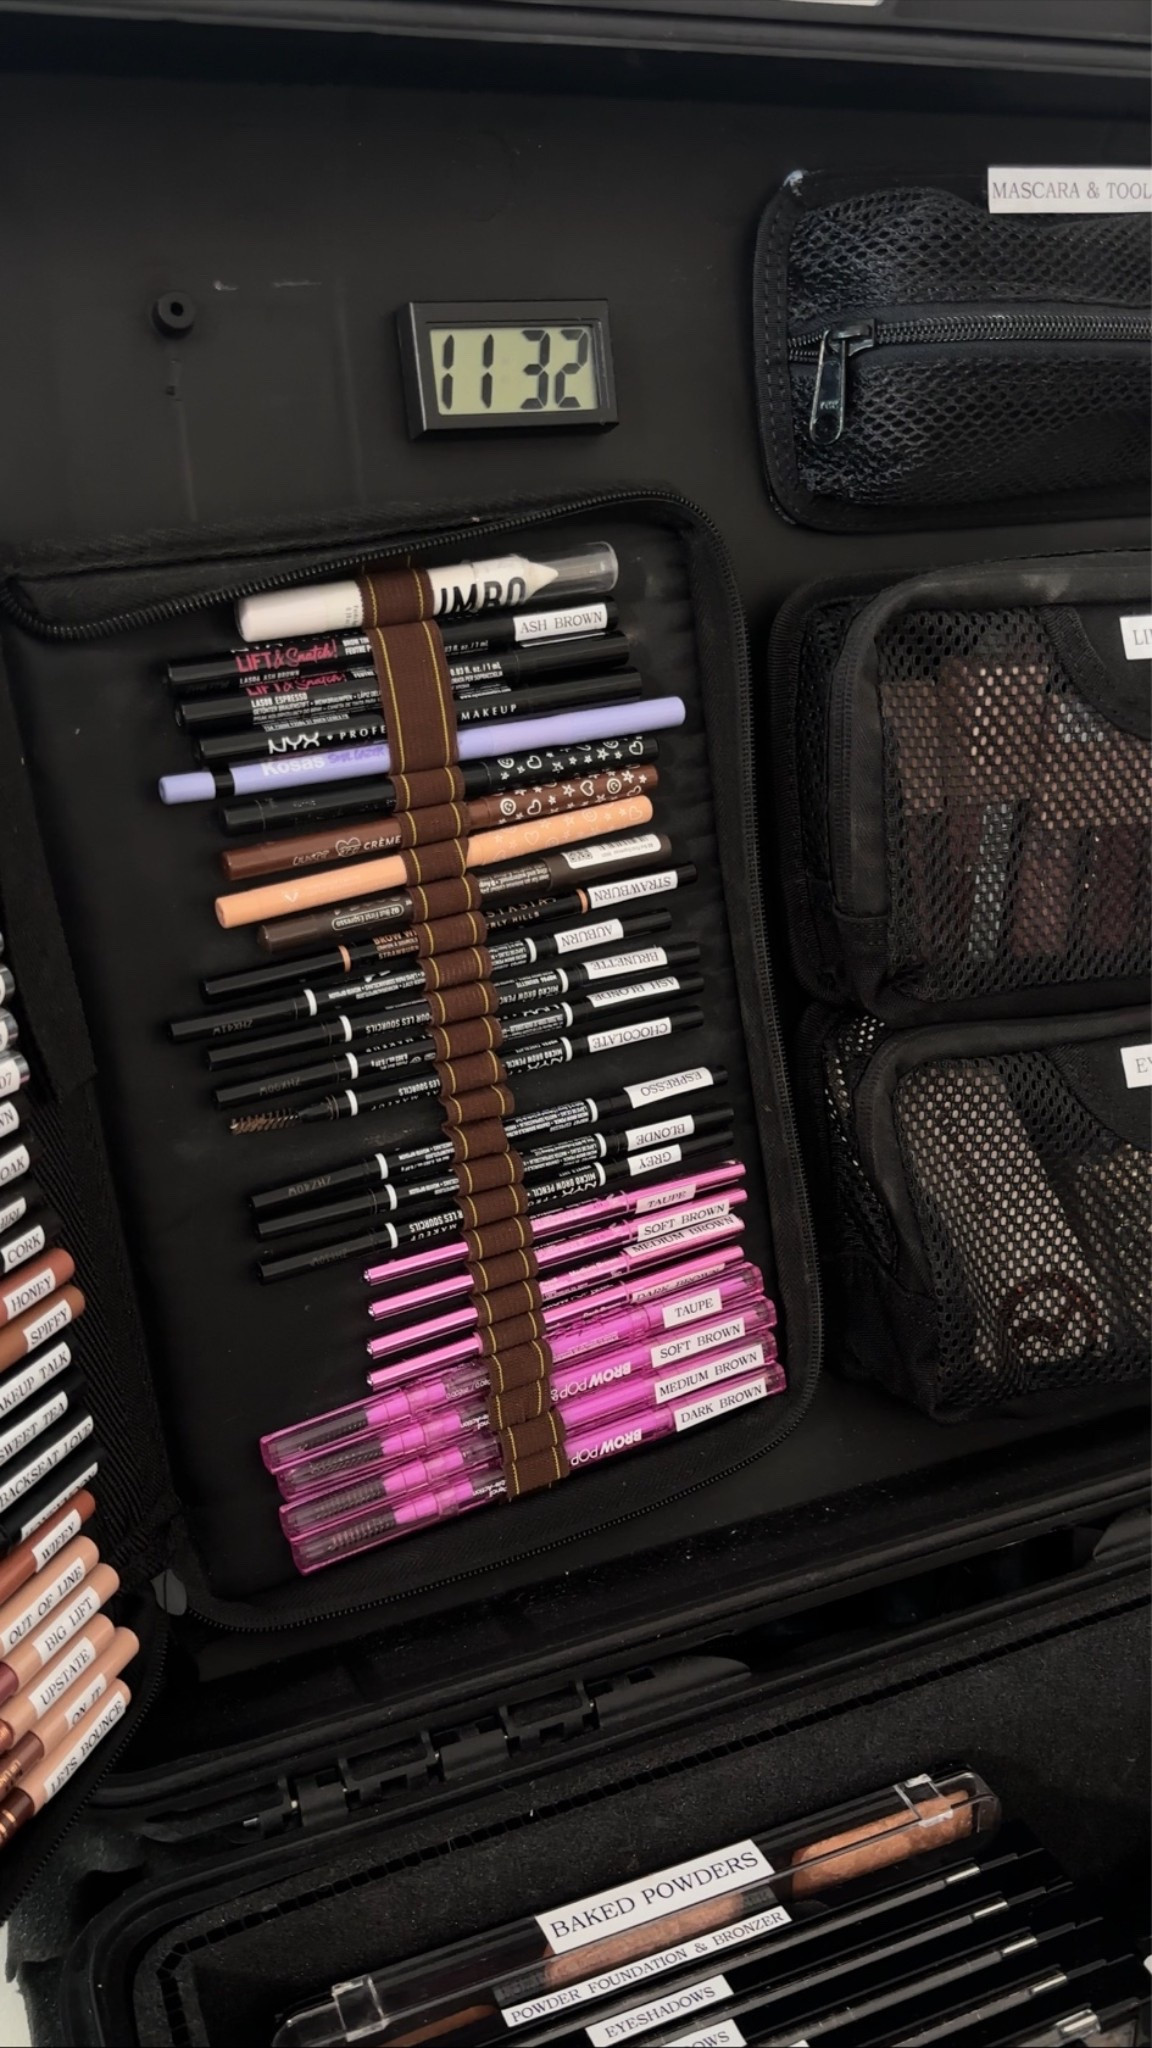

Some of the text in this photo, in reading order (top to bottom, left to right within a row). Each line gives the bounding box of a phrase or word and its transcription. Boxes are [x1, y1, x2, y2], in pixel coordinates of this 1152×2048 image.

[992, 182, 1081, 199] MASCARA
[1087, 182, 1100, 199] &
[521, 611, 603, 634] ASH BROWN
[235, 651, 271, 672] LIFT
[268, 732, 320, 754] NYX
[461, 704, 517, 720] MAKEUP
[261, 756, 326, 776] Kosas
[363, 835, 401, 850] CRÈME
[594, 875, 672, 902] STRAWBURN
[561, 924, 613, 947] AUBURN
[591, 951, 660, 971] BRUNETTE
[593, 1022, 668, 1049] CHOCOLATE
[640, 1071, 703, 1097] ESPRESSO
[635, 1123, 686, 1141] BLONDE
[638, 1152, 672, 1170] GREY
[531, 1183, 555, 1197] PENCIL
[647, 1190, 687, 1208] TAUPE
[407, 1215, 443, 1232] SOURCILS
[442, 1211, 457, 1223] LES
[643, 1204, 725, 1236] SOFT BROWN
[8, 1232, 41, 1264] CORK
[632, 1216, 734, 1253] MEDIUM BROWN
[11, 1278, 52, 1312] HONEY
[674, 1298, 714, 1318] TAUPE
[30, 1308, 69, 1345] SPIFFY
[660, 1324, 742, 1359] SOFT BROWN
[38, 1350, 69, 1381] TALK
[659, 1352, 758, 1397] MEDIUM BROWN
[42, 1402, 65, 1426] TEA
[680, 1385, 763, 1423] DARK BROWN
[63, 1421, 92, 1451] LOVE
[8, 1565, 84, 1646] OUT OF LINE
[44, 1597, 94, 1652] BIG LIFT
[41, 1648, 91, 1706] UPSTATE
[80, 1700, 124, 1757] BOUNCE
[549, 1851, 759, 1940] BAKED POWDERS
[511, 1911, 785, 2023] POWDER FOUNDATION & BRONZER
[604, 1986, 716, 2040] EYESHADOWS
